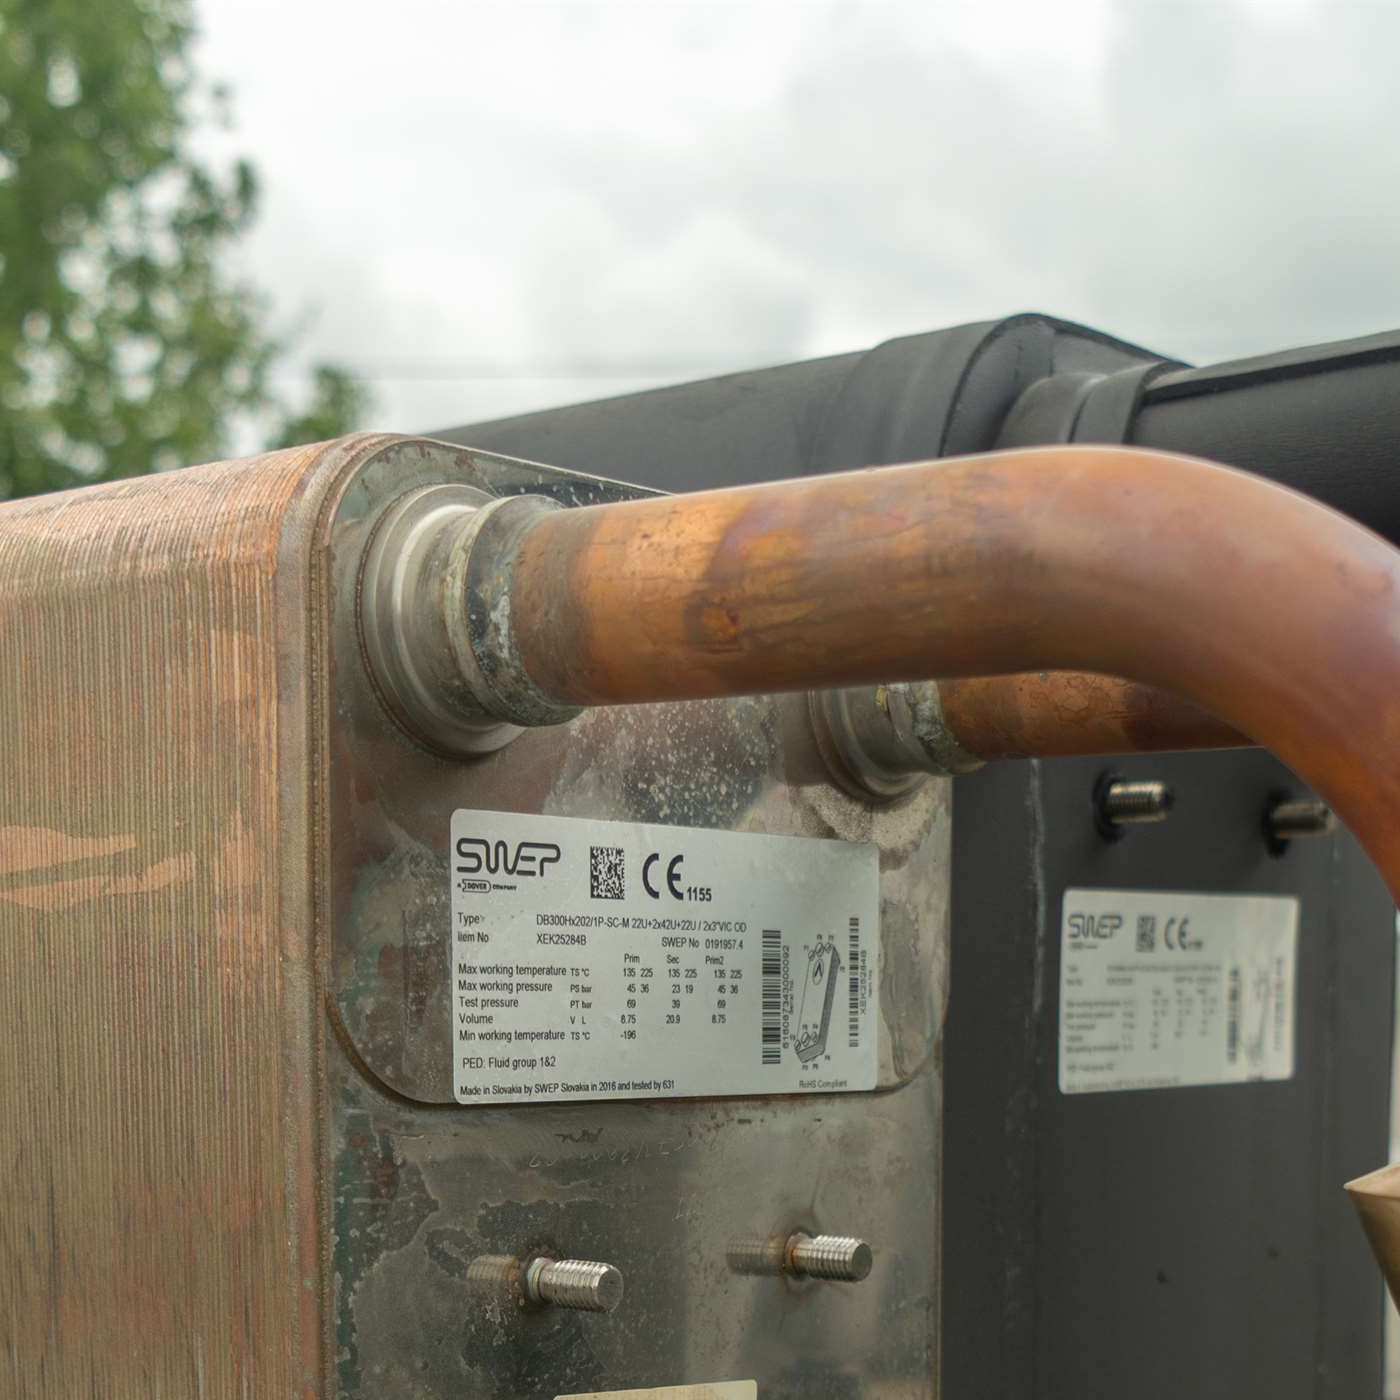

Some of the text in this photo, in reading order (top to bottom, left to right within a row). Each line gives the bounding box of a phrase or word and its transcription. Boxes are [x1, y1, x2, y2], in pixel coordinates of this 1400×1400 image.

[456, 837, 560, 877] SWEP
[642, 853, 712, 902] CE 1155
[467, 882, 487, 890] DOVER
[458, 912, 480, 927] Type
[536, 914, 630, 930] DB300Hx202/1P-SC-M
[631, 918, 697, 932] 22U+2x42U+22U
[1068, 914, 1123, 939] SWEP
[457, 931, 587, 946] Item No XEK25284B
[662, 937, 743, 950] SWEP No 0191957.4
[624, 953, 724, 966] Prim Sec Prim2
[458, 963, 743, 979] Max working temperature TS °C 135 225 135 225 135 225
[458, 979, 739, 994] Max working pressure PS bar 45 36 23 19 45 36
[459, 996, 726, 1010] Test pressure PT bar 69 39 69
[459, 1012, 726, 1025] Volume V L 8.75 20.9 8.75
[459, 1029, 637, 1043] Min working temperature TS °C -196
[462, 1056, 556, 1071] PED: Fluid group 1&2
[460, 1079, 675, 1097] Made in Slovakia by SWEP Slovakia in 2016 and tested by 631
